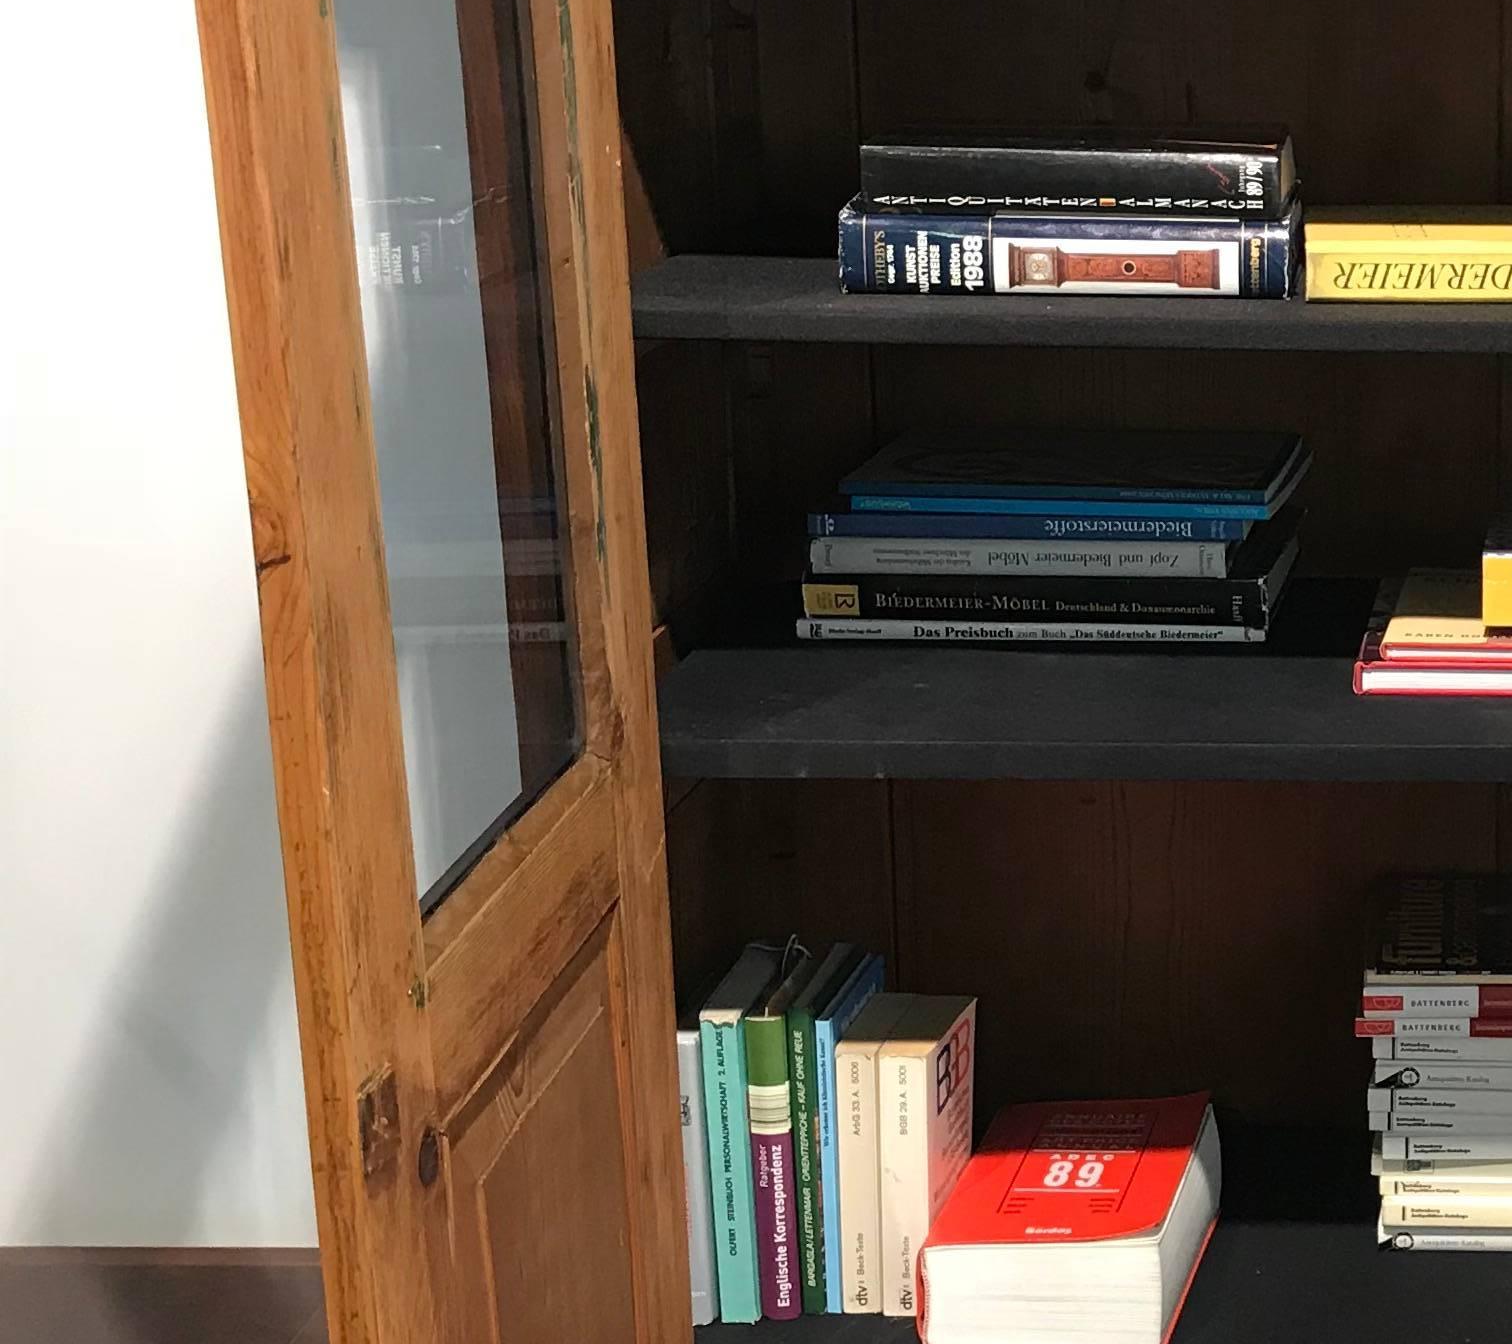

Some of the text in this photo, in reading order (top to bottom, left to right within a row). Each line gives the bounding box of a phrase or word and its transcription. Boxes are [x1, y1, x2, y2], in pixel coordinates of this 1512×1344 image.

[905, 244, 917, 284] KUNST
[929, 244, 942, 284] PREISE
[950, 242, 962, 286] Edition
[962, 235, 984, 291] 1988
[1043, 519, 1193, 538] Biedermeierstoffe
[987, 551, 1178, 568] Zopf und Biedermeier Möbel
[875, 591, 1216, 615] BIEDERMEIER-MÖBEL Deutschland Donaumonarchie
[913, 626, 1157, 640] Das Preisbuch zum Buch Süddeutsche
[1410, 1000, 1470, 1008] BATTENBERG
[1401, 1024, 1462, 1032] BATTENBERG
[794, 1052, 805, 1076] OHNE
[795, 1077, 807, 1102] KAUF
[719, 1081, 732, 1174] PERSONALWIRTSCHAFT
[853, 1116, 861, 1137] ArbG
[899, 1119, 909, 1136] BGB
[799, 1111, 812, 1183] ORIENTTEPPICHE
[759, 1144, 768, 1188] Ratgeber
[1042, 1160, 1105, 1188] 89
[726, 1176, 737, 1222] STEINBUCH
[769, 1144, 791, 1308] Englische Korrespondenz
[729, 1228, 738, 1256] OLFERT
[856, 1232, 868, 1306] dtv Beck-Texte
[900, 1236, 913, 1311] dtv Beck-Texte
